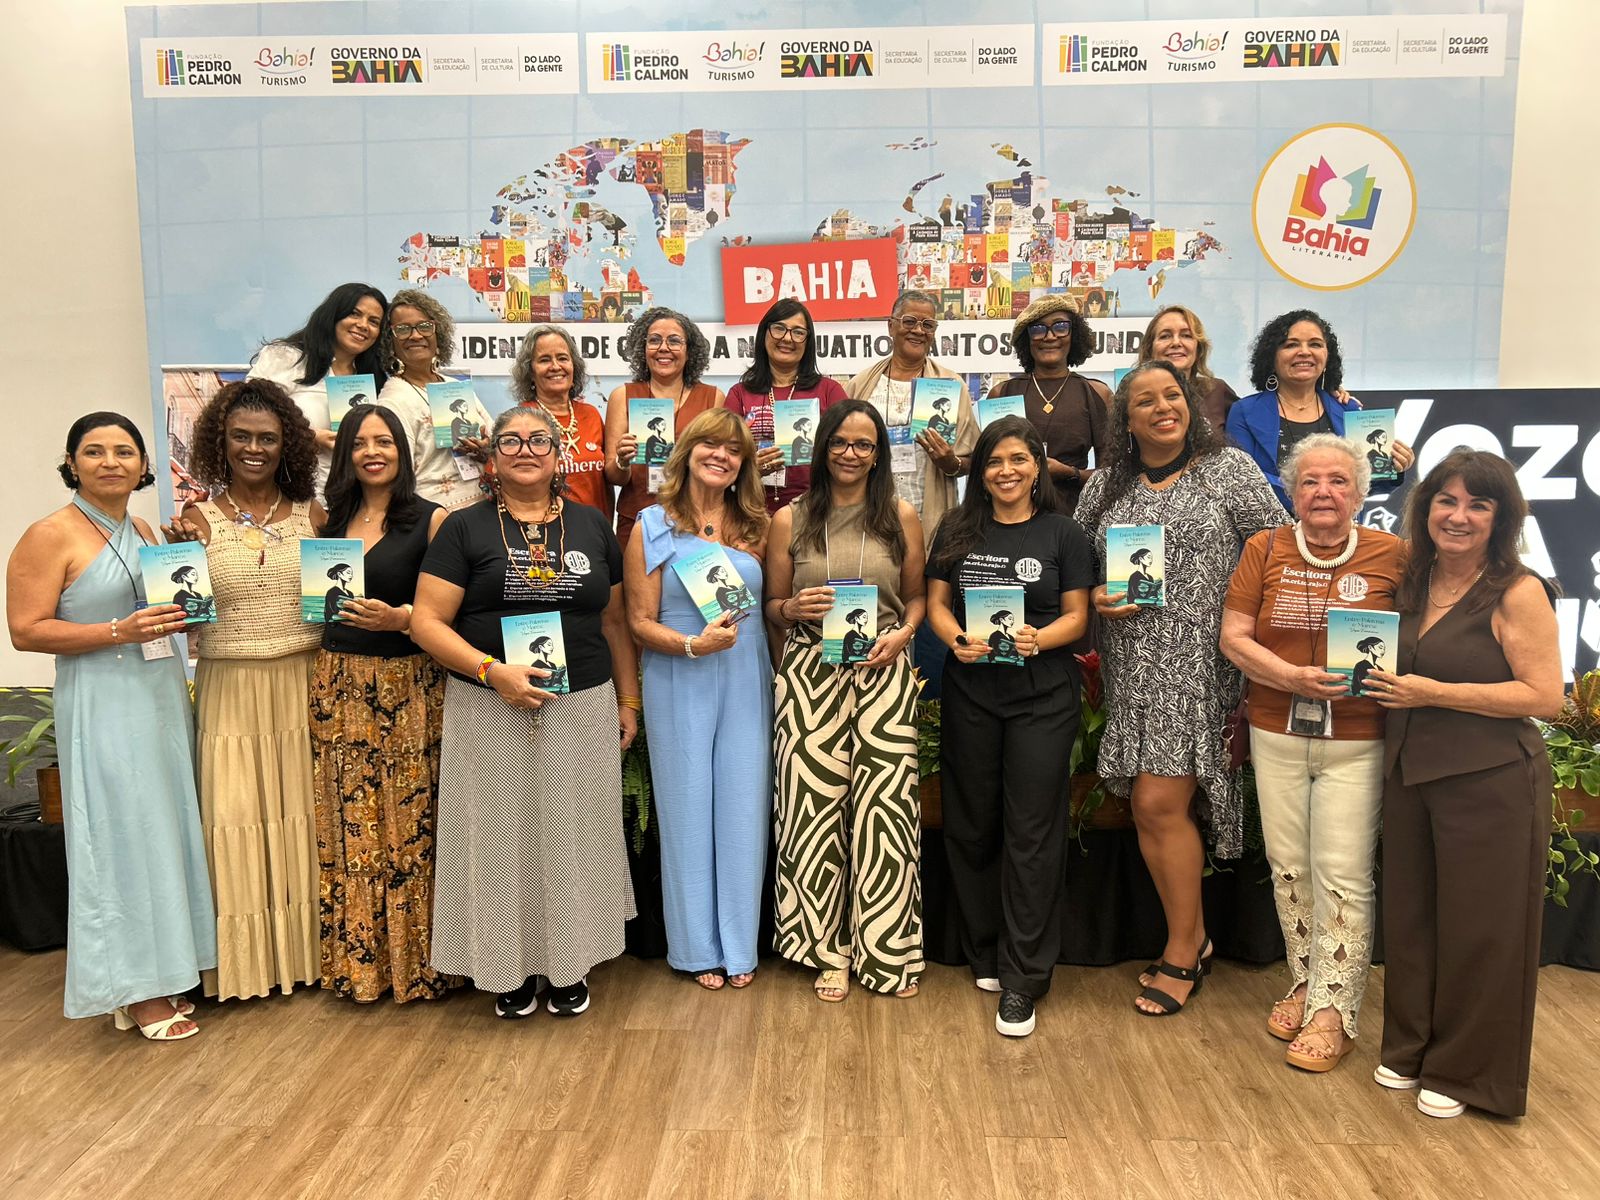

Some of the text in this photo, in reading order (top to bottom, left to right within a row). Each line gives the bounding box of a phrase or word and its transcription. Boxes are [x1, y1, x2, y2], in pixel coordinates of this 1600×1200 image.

[1162, 30, 1229, 52] Bahia!
[1245, 28, 1340, 43] GOVERNO DA
[1449, 36, 1488, 45] DO LADO
[331, 47, 421, 60] GOVERNO DA
[702, 41, 765, 61] Bahia!
[781, 40, 873, 54] GOVERNO DA
[978, 47, 1015, 56] DO LADO
[1091, 46, 1138, 59] PEDRO
[1448, 45, 1489, 55] DA GENTE
[254, 46, 316, 68] Bahia!
[524, 55, 561, 63] DO LADO
[634, 55, 679, 67] PEDRO
[978, 56, 1018, 65] DA GENTE
[1243, 42, 1340, 68] BAHIA
[188, 61, 232, 72] PEDRO
[332, 60, 422, 83] BAHIA
[524, 63, 563, 72] DA GENTE
[781, 53, 873, 78] BAHIA
[1091, 59, 1147, 72] CALMON
[1168, 61, 1216, 71] TURISMO
[188, 73, 241, 85] CALMON
[260, 75, 307, 86] TURISMO
[634, 68, 688, 81] CALMON
[708, 70, 755, 81] TURISMO
[1282, 217, 1369, 257] Bahia
[1292, 246, 1352, 261] LITERÁRIA
[743, 258, 877, 304] BAHIA
[506, 292, 529, 309] VIVA
[988, 287, 1010, 305] VIVA
[816, 335, 892, 357] UATRO
[966, 552, 1009, 563] Escritora
[1283, 566, 1332, 581] Escritora
